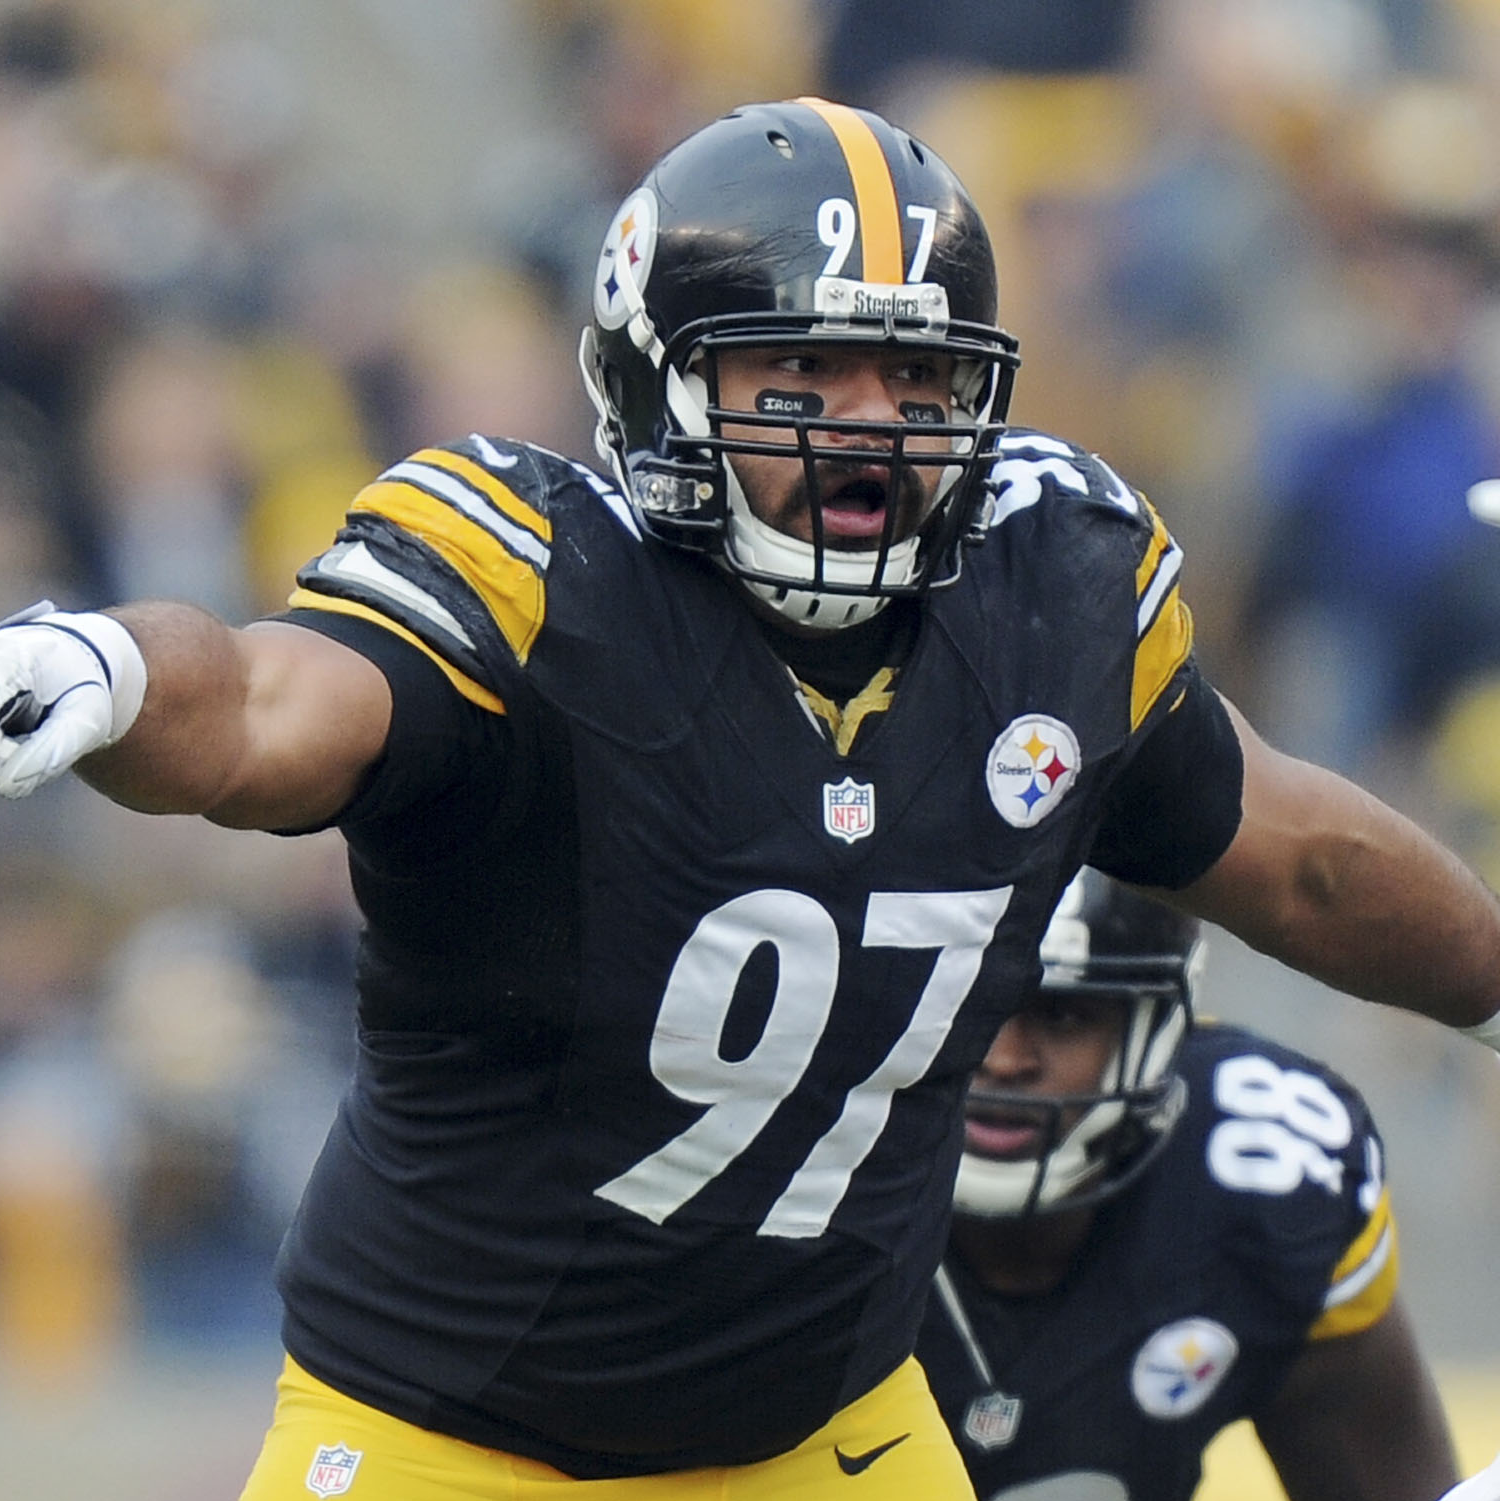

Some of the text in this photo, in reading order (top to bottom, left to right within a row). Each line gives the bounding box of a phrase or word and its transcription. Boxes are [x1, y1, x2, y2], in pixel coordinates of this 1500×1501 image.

[854, 289, 918, 316] Steelers
[764, 397, 803, 412] IRON
[996, 762, 1032, 776] Steelers
[833, 806, 867, 831] NFL
[593, 884, 1014, 1238] 97
[1206, 1053, 1353, 1196] 98
[313, 1466, 346, 1488] NFL
